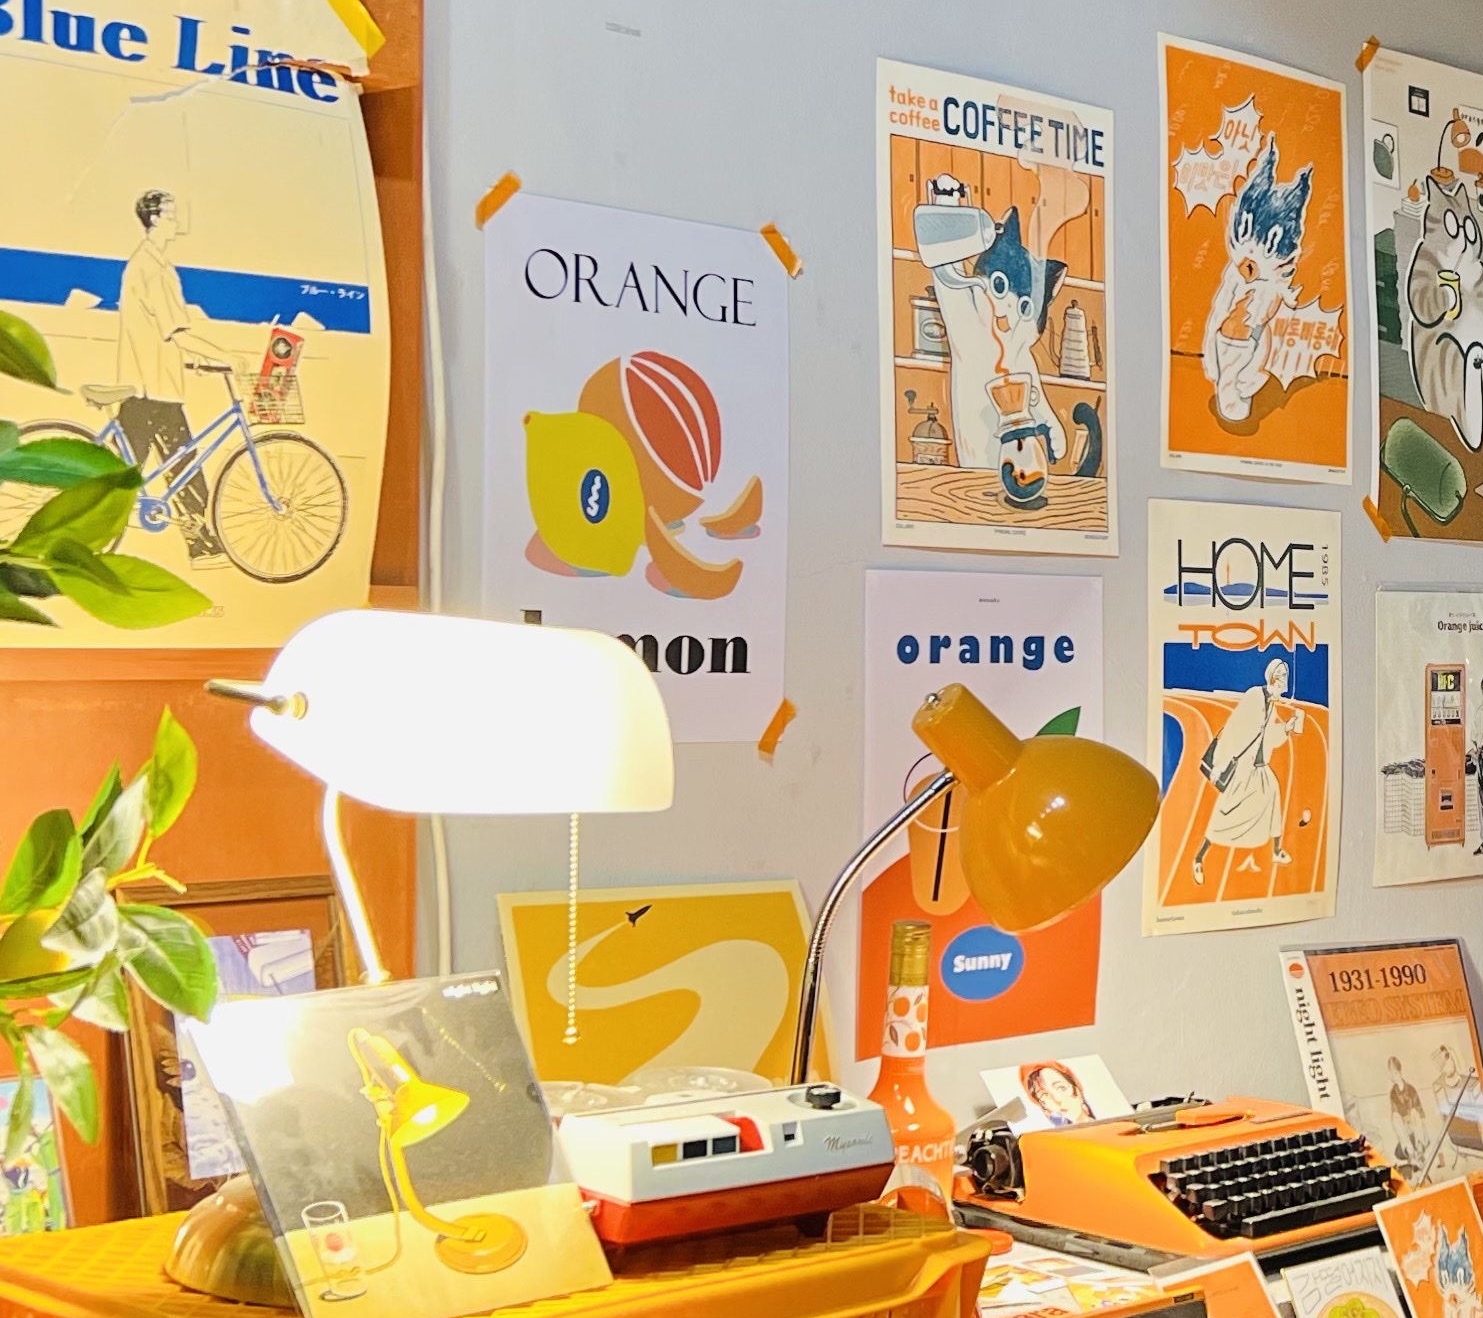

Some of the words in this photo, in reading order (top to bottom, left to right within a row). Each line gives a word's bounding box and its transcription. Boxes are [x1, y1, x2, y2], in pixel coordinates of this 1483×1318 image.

[172, 15, 340, 103] Line
[889, 85, 926, 109] take
[929, 98, 939, 112] a
[889, 109, 941, 132] coffee
[943, 96, 1044, 155] COFFEE
[1048, 118, 1105, 168] TIME
[523, 247, 758, 328] ORANGE
[1177, 537, 1315, 611] HOME
[1178, 618, 1316, 652] TOWN
[1437, 620, 1468, 634] Orange
[896, 634, 1075, 671] orange
[952, 952, 1013, 973] Sunny
[1327, 963, 1427, 994] 1931-1990
[1294, 987, 1319, 1046] night
[1309, 1050, 1331, 1101] light
